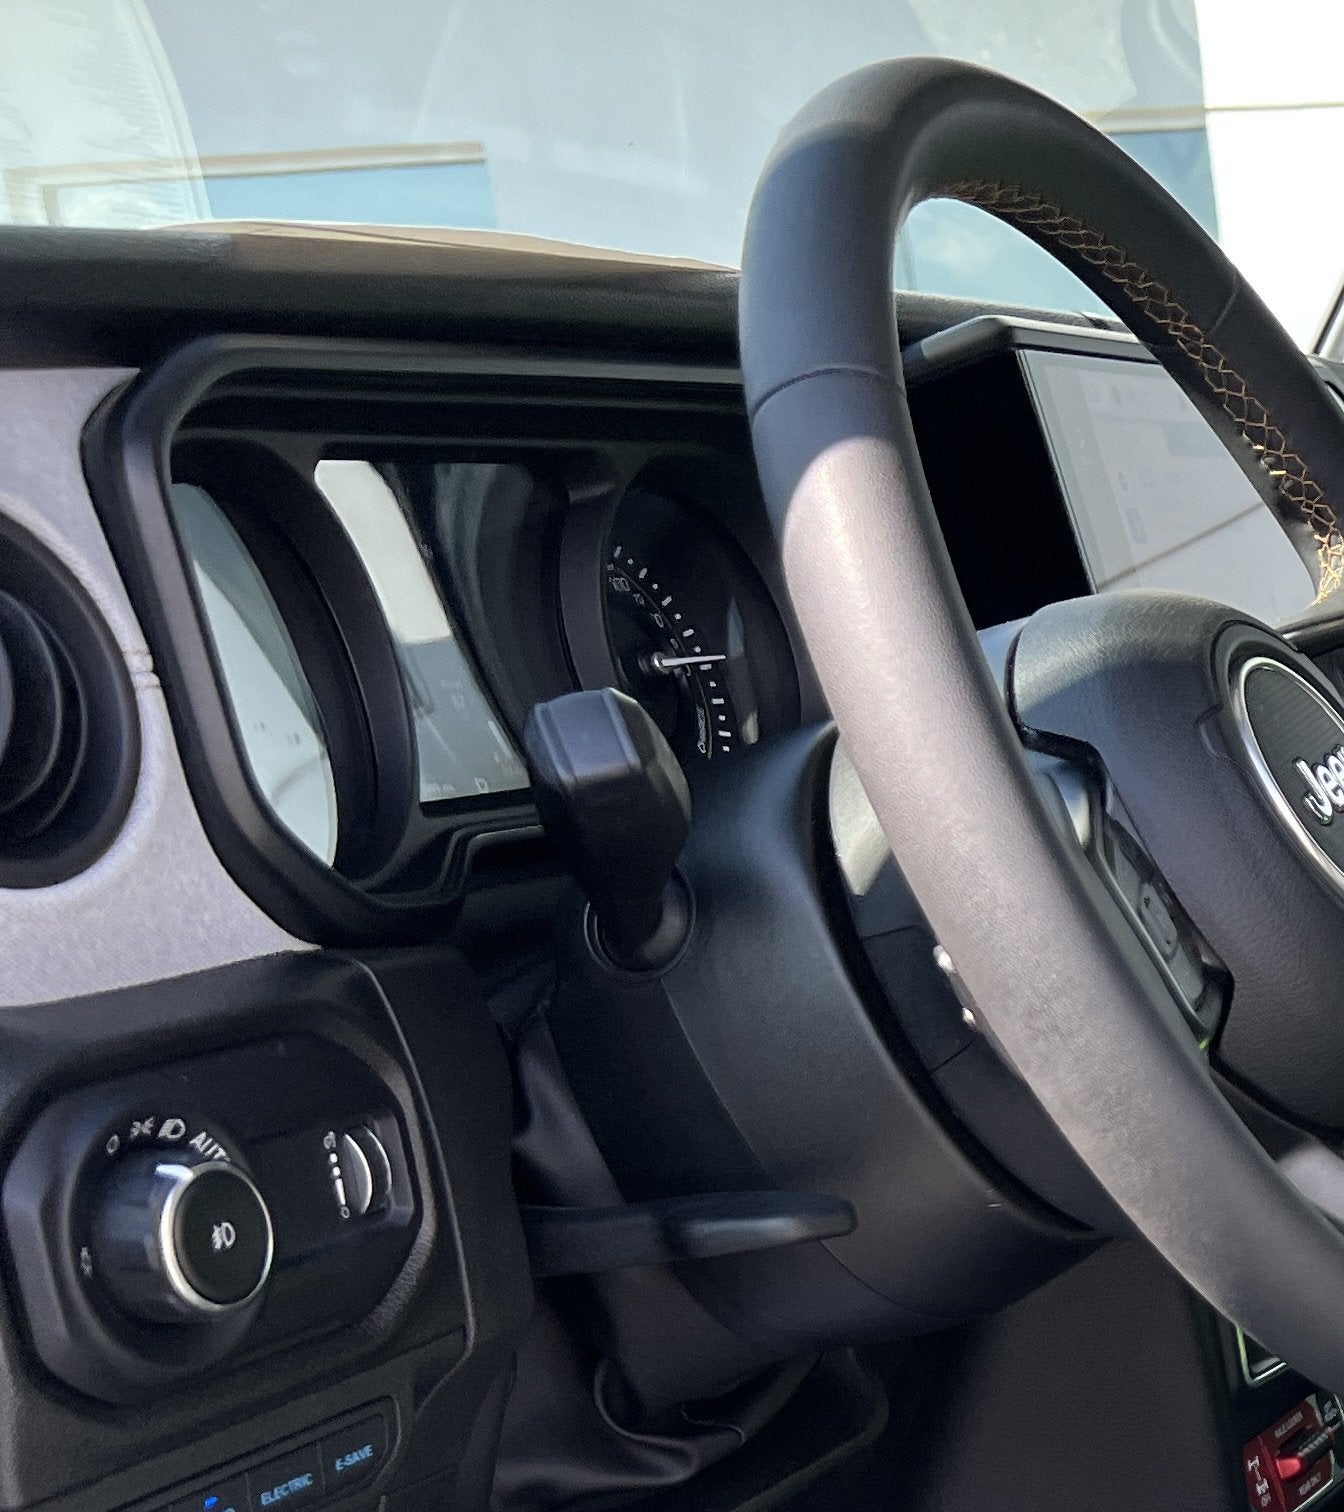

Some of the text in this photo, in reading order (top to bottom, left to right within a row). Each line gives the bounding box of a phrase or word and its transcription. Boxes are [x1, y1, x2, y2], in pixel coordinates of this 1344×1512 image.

[189, 1131, 230, 1162] AUT
[335, 1444, 374, 1471] E-SAVE
[261, 1472, 314, 1506] ELECTRIC
